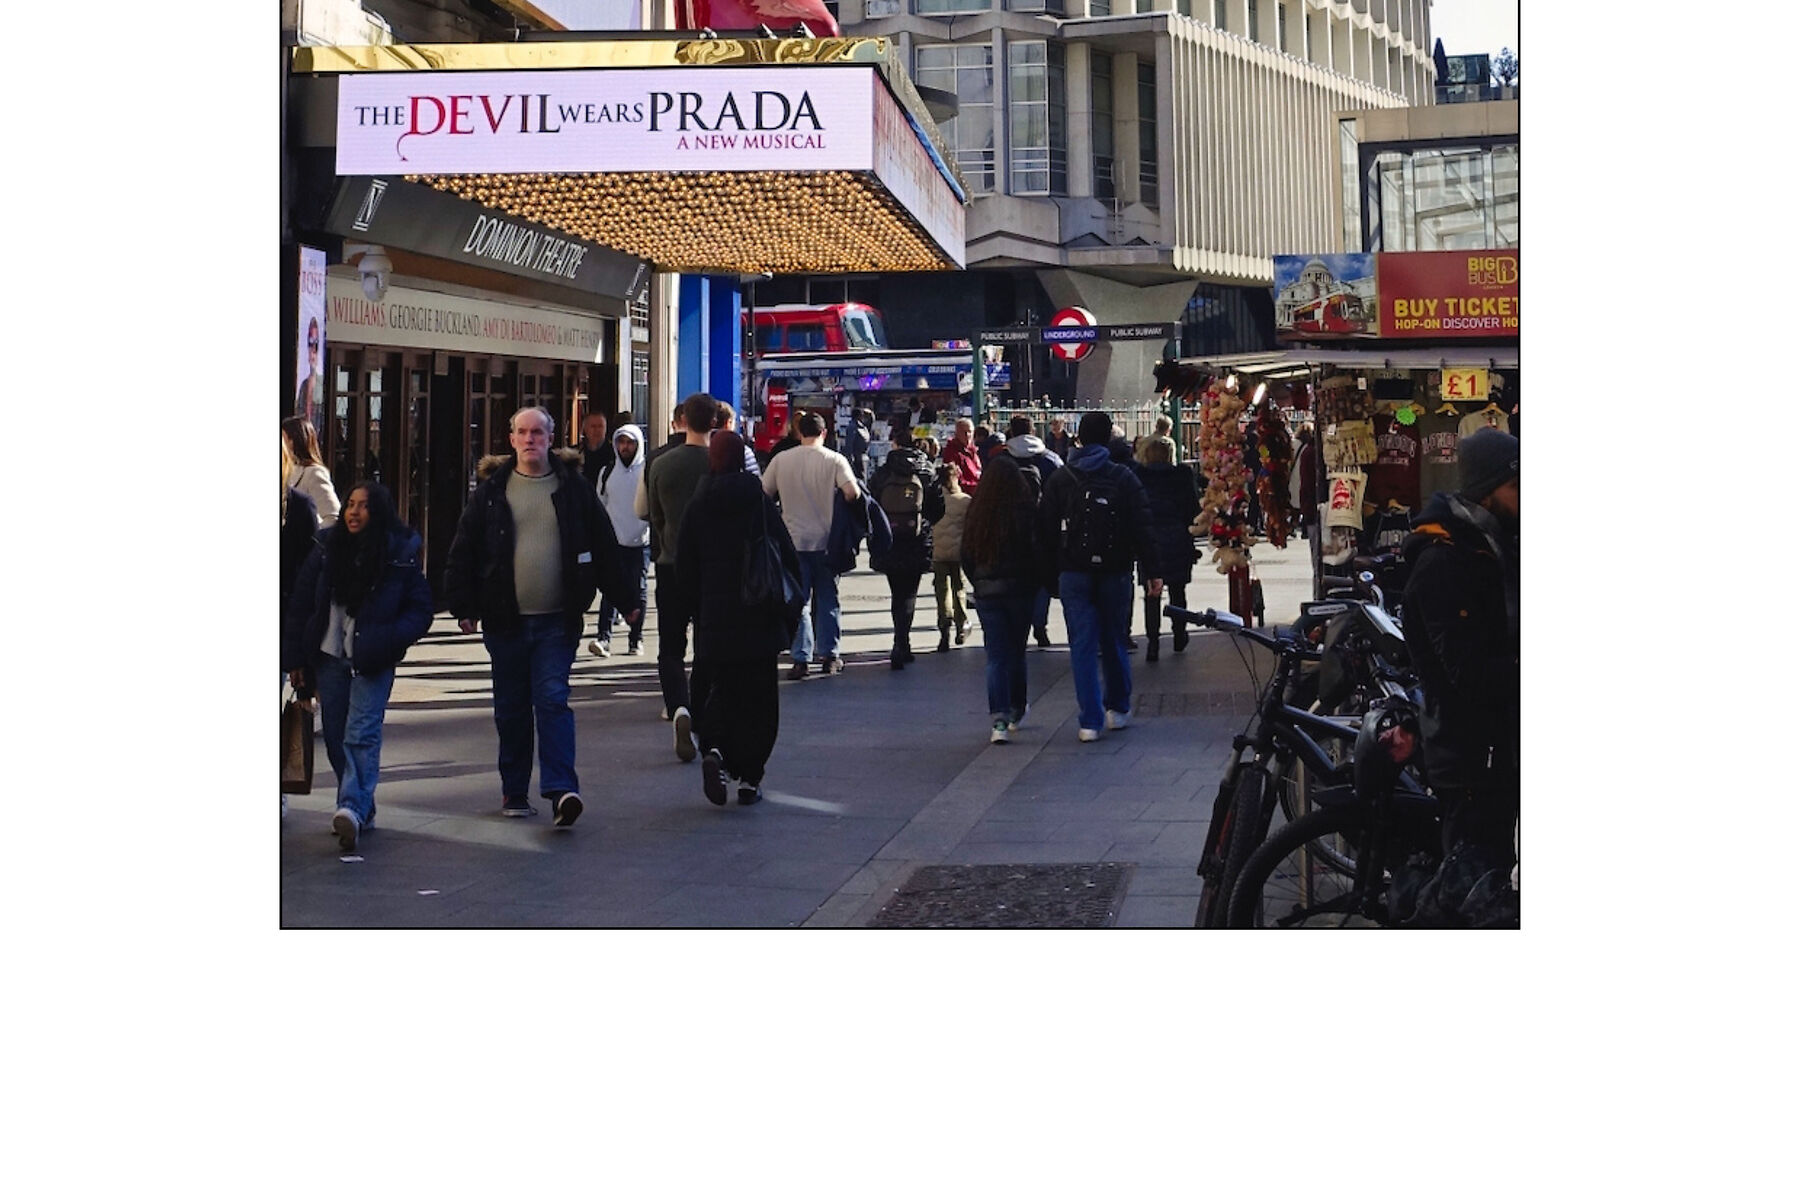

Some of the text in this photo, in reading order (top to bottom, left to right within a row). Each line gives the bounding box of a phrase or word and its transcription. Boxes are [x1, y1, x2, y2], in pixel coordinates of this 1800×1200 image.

[354, 90, 826, 162] THE DEVIL WEARS PRADA
[677, 134, 826, 150] A NEW MUSICAL
[463, 214, 588, 279] DOMINION THEATRE
[1468, 257, 1495, 271] BIG
[1468, 271, 1496, 285] BUS
[1395, 299, 1438, 317] BUY
[389, 304, 432, 331] GEORGIE
[1395, 318, 1440, 330] HOP-ON
[1442, 317, 1500, 329] DISCOVER
[981, 332, 1030, 340] PUBLIC SUBWAY
[1043, 329, 1096, 340] UNDERGROUND
[1110, 326, 1163, 337] PUBLIC SUBWAY
[1447, 375, 1477, 397] £1
